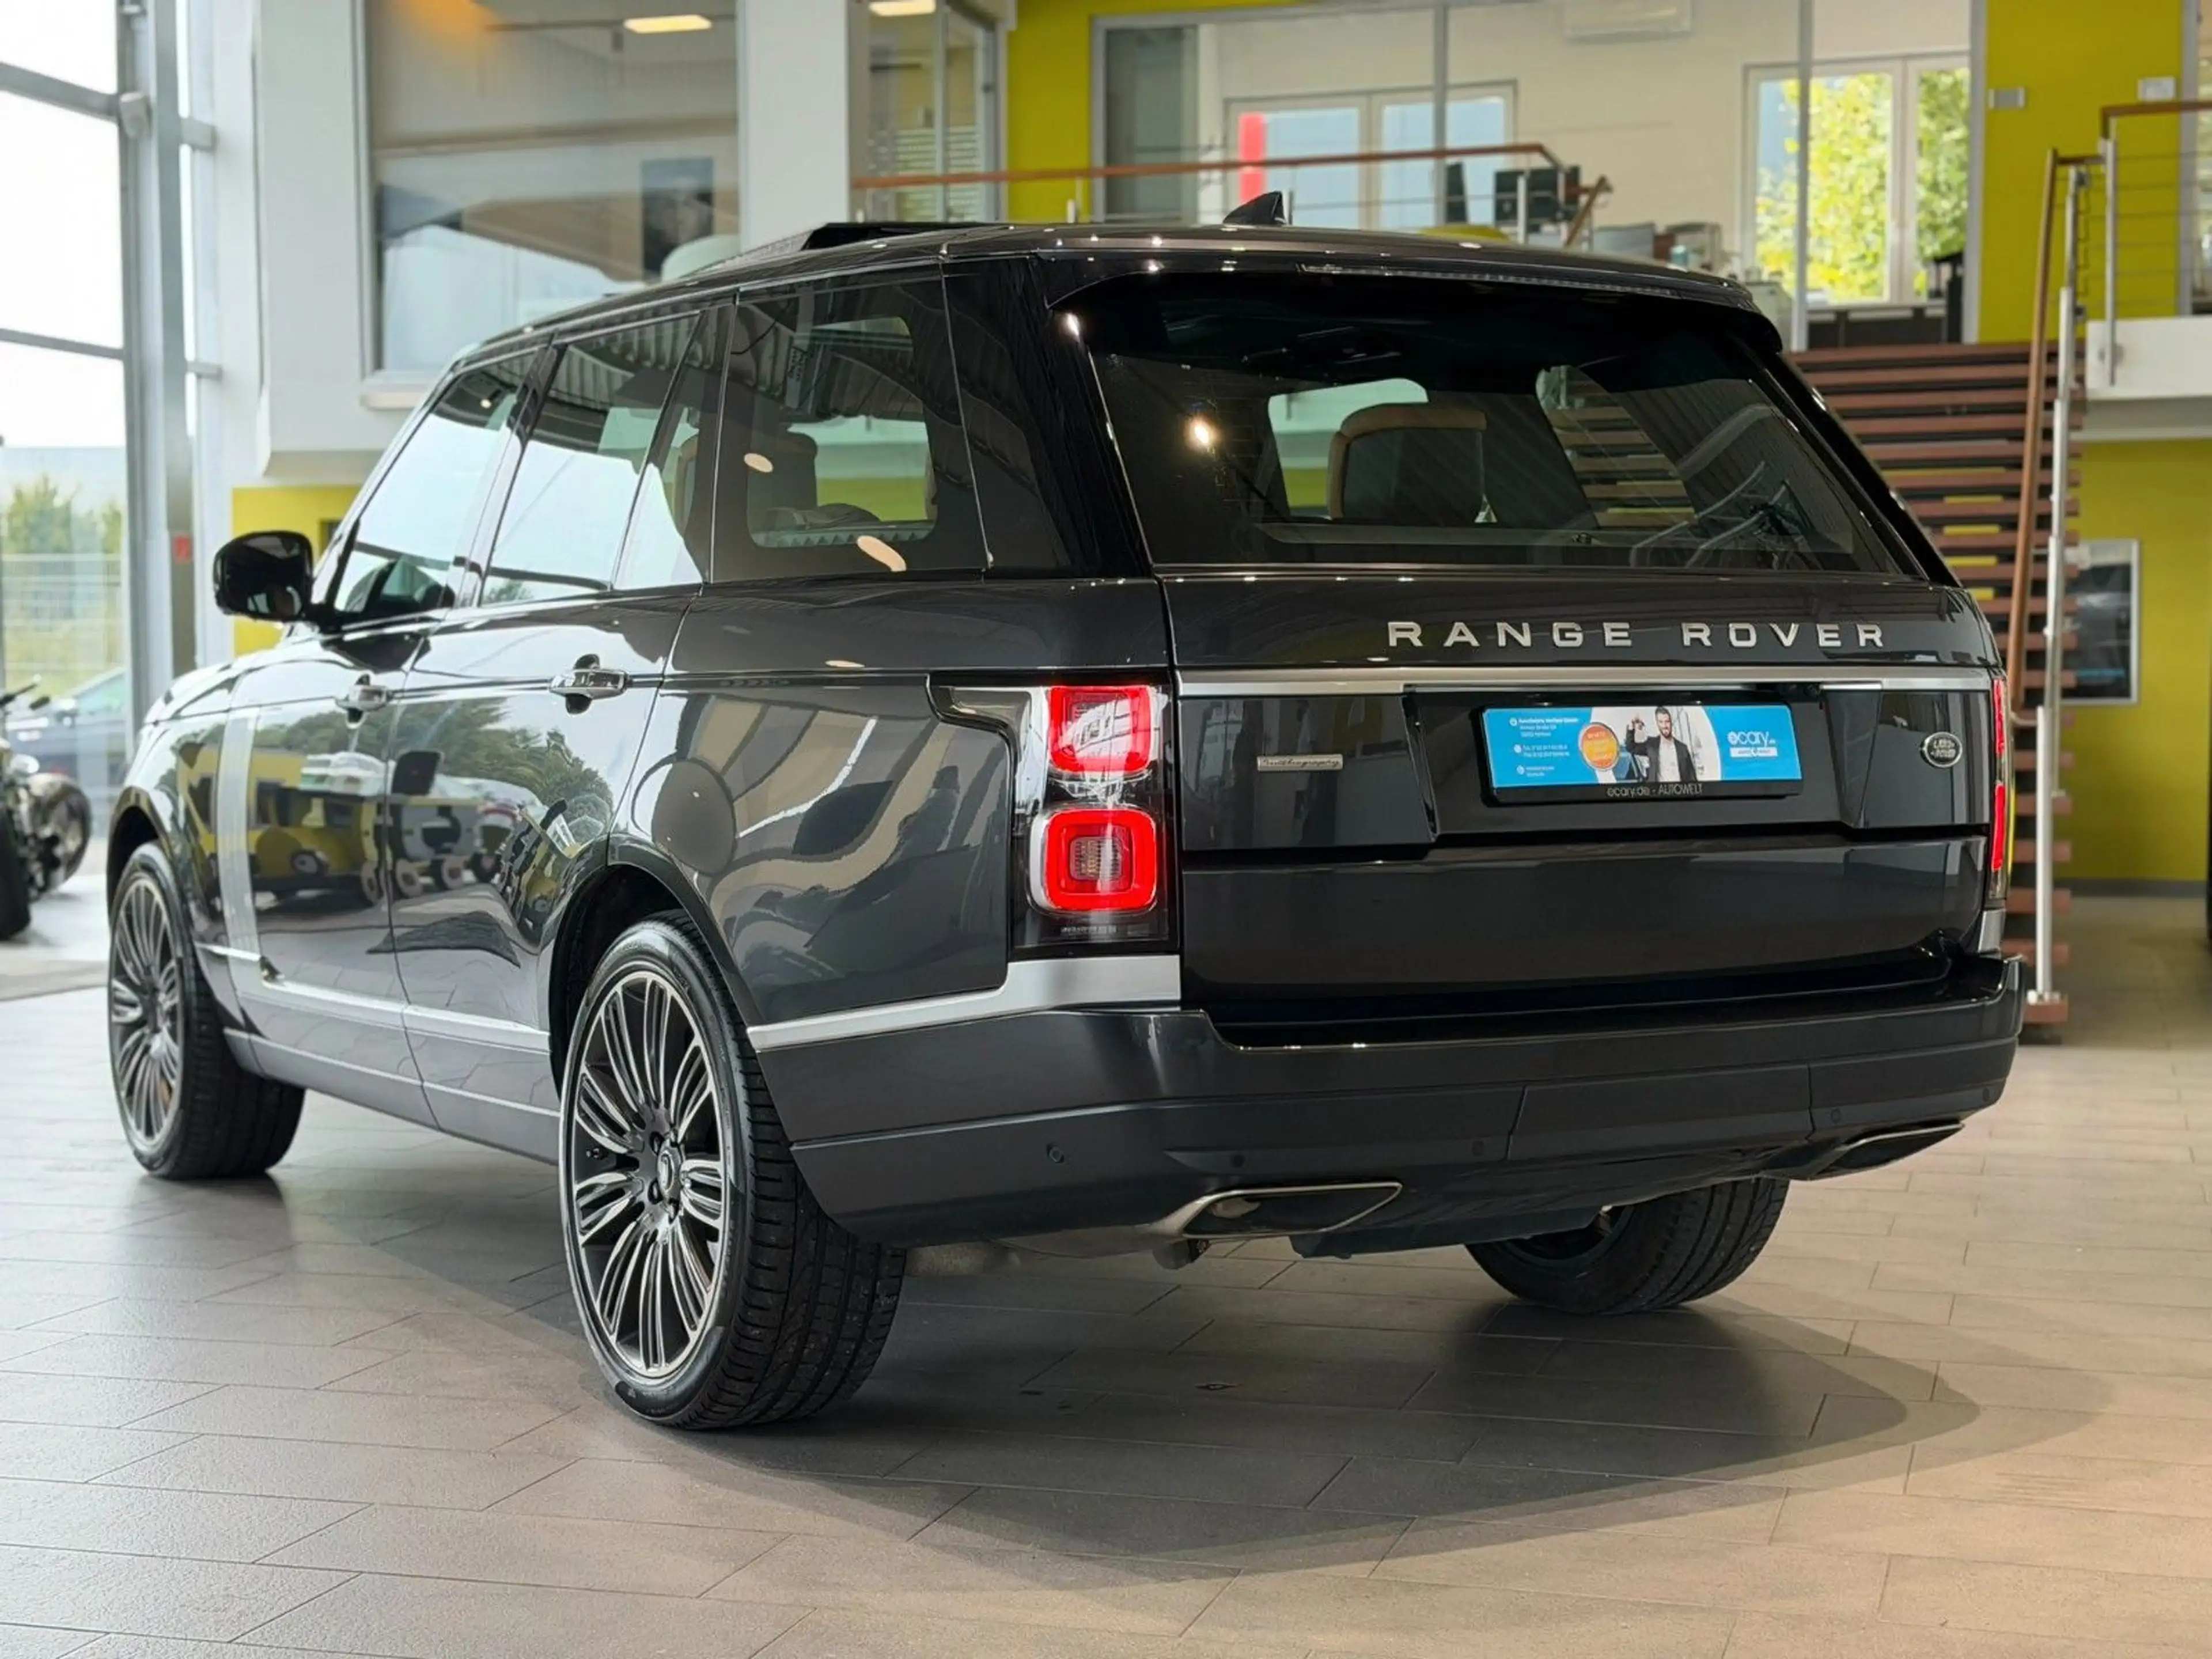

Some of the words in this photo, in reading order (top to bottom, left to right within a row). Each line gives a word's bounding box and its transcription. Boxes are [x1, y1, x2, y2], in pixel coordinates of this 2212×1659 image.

[1387, 621, 1633, 647] RANGE
[1682, 622, 1884, 647] ROVER
[1658, 783, 1703, 796] AUTOWELT
